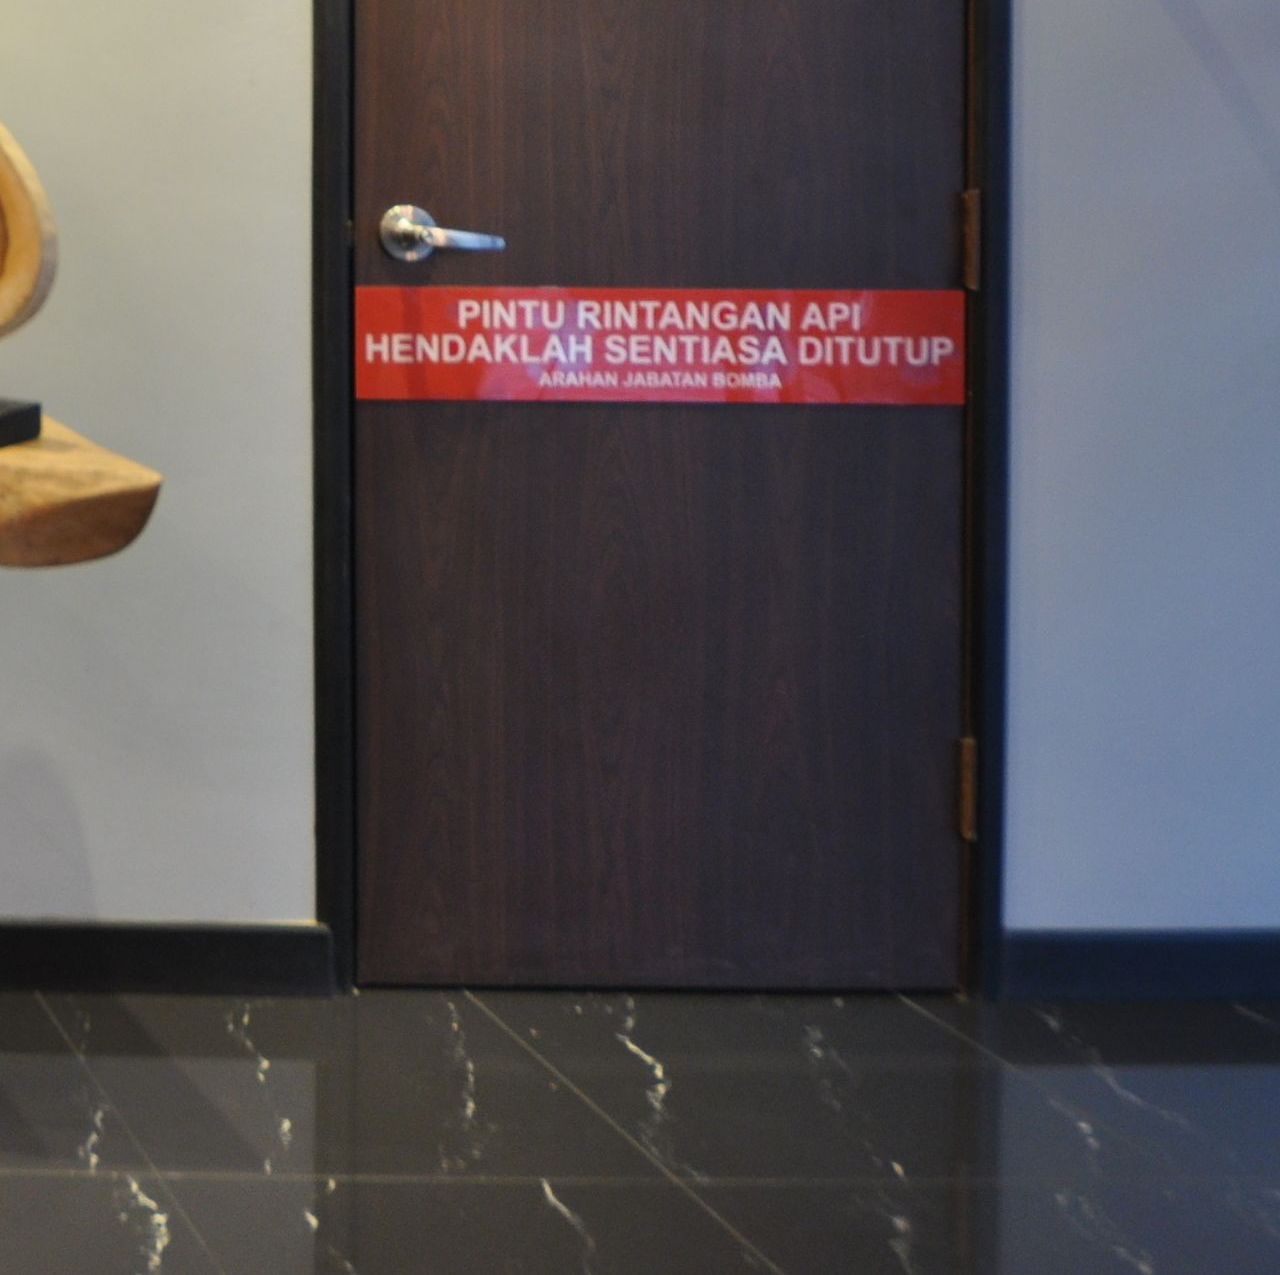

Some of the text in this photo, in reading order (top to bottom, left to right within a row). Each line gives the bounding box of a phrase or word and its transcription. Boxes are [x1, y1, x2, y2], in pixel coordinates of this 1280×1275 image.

[457, 299, 861, 332] PINTU RINTANGAN API
[365, 333, 954, 366] HENDAKLAH SENTIASA DITUTUP
[539, 371, 782, 389] ARAHAN JABATAN BOMBA
